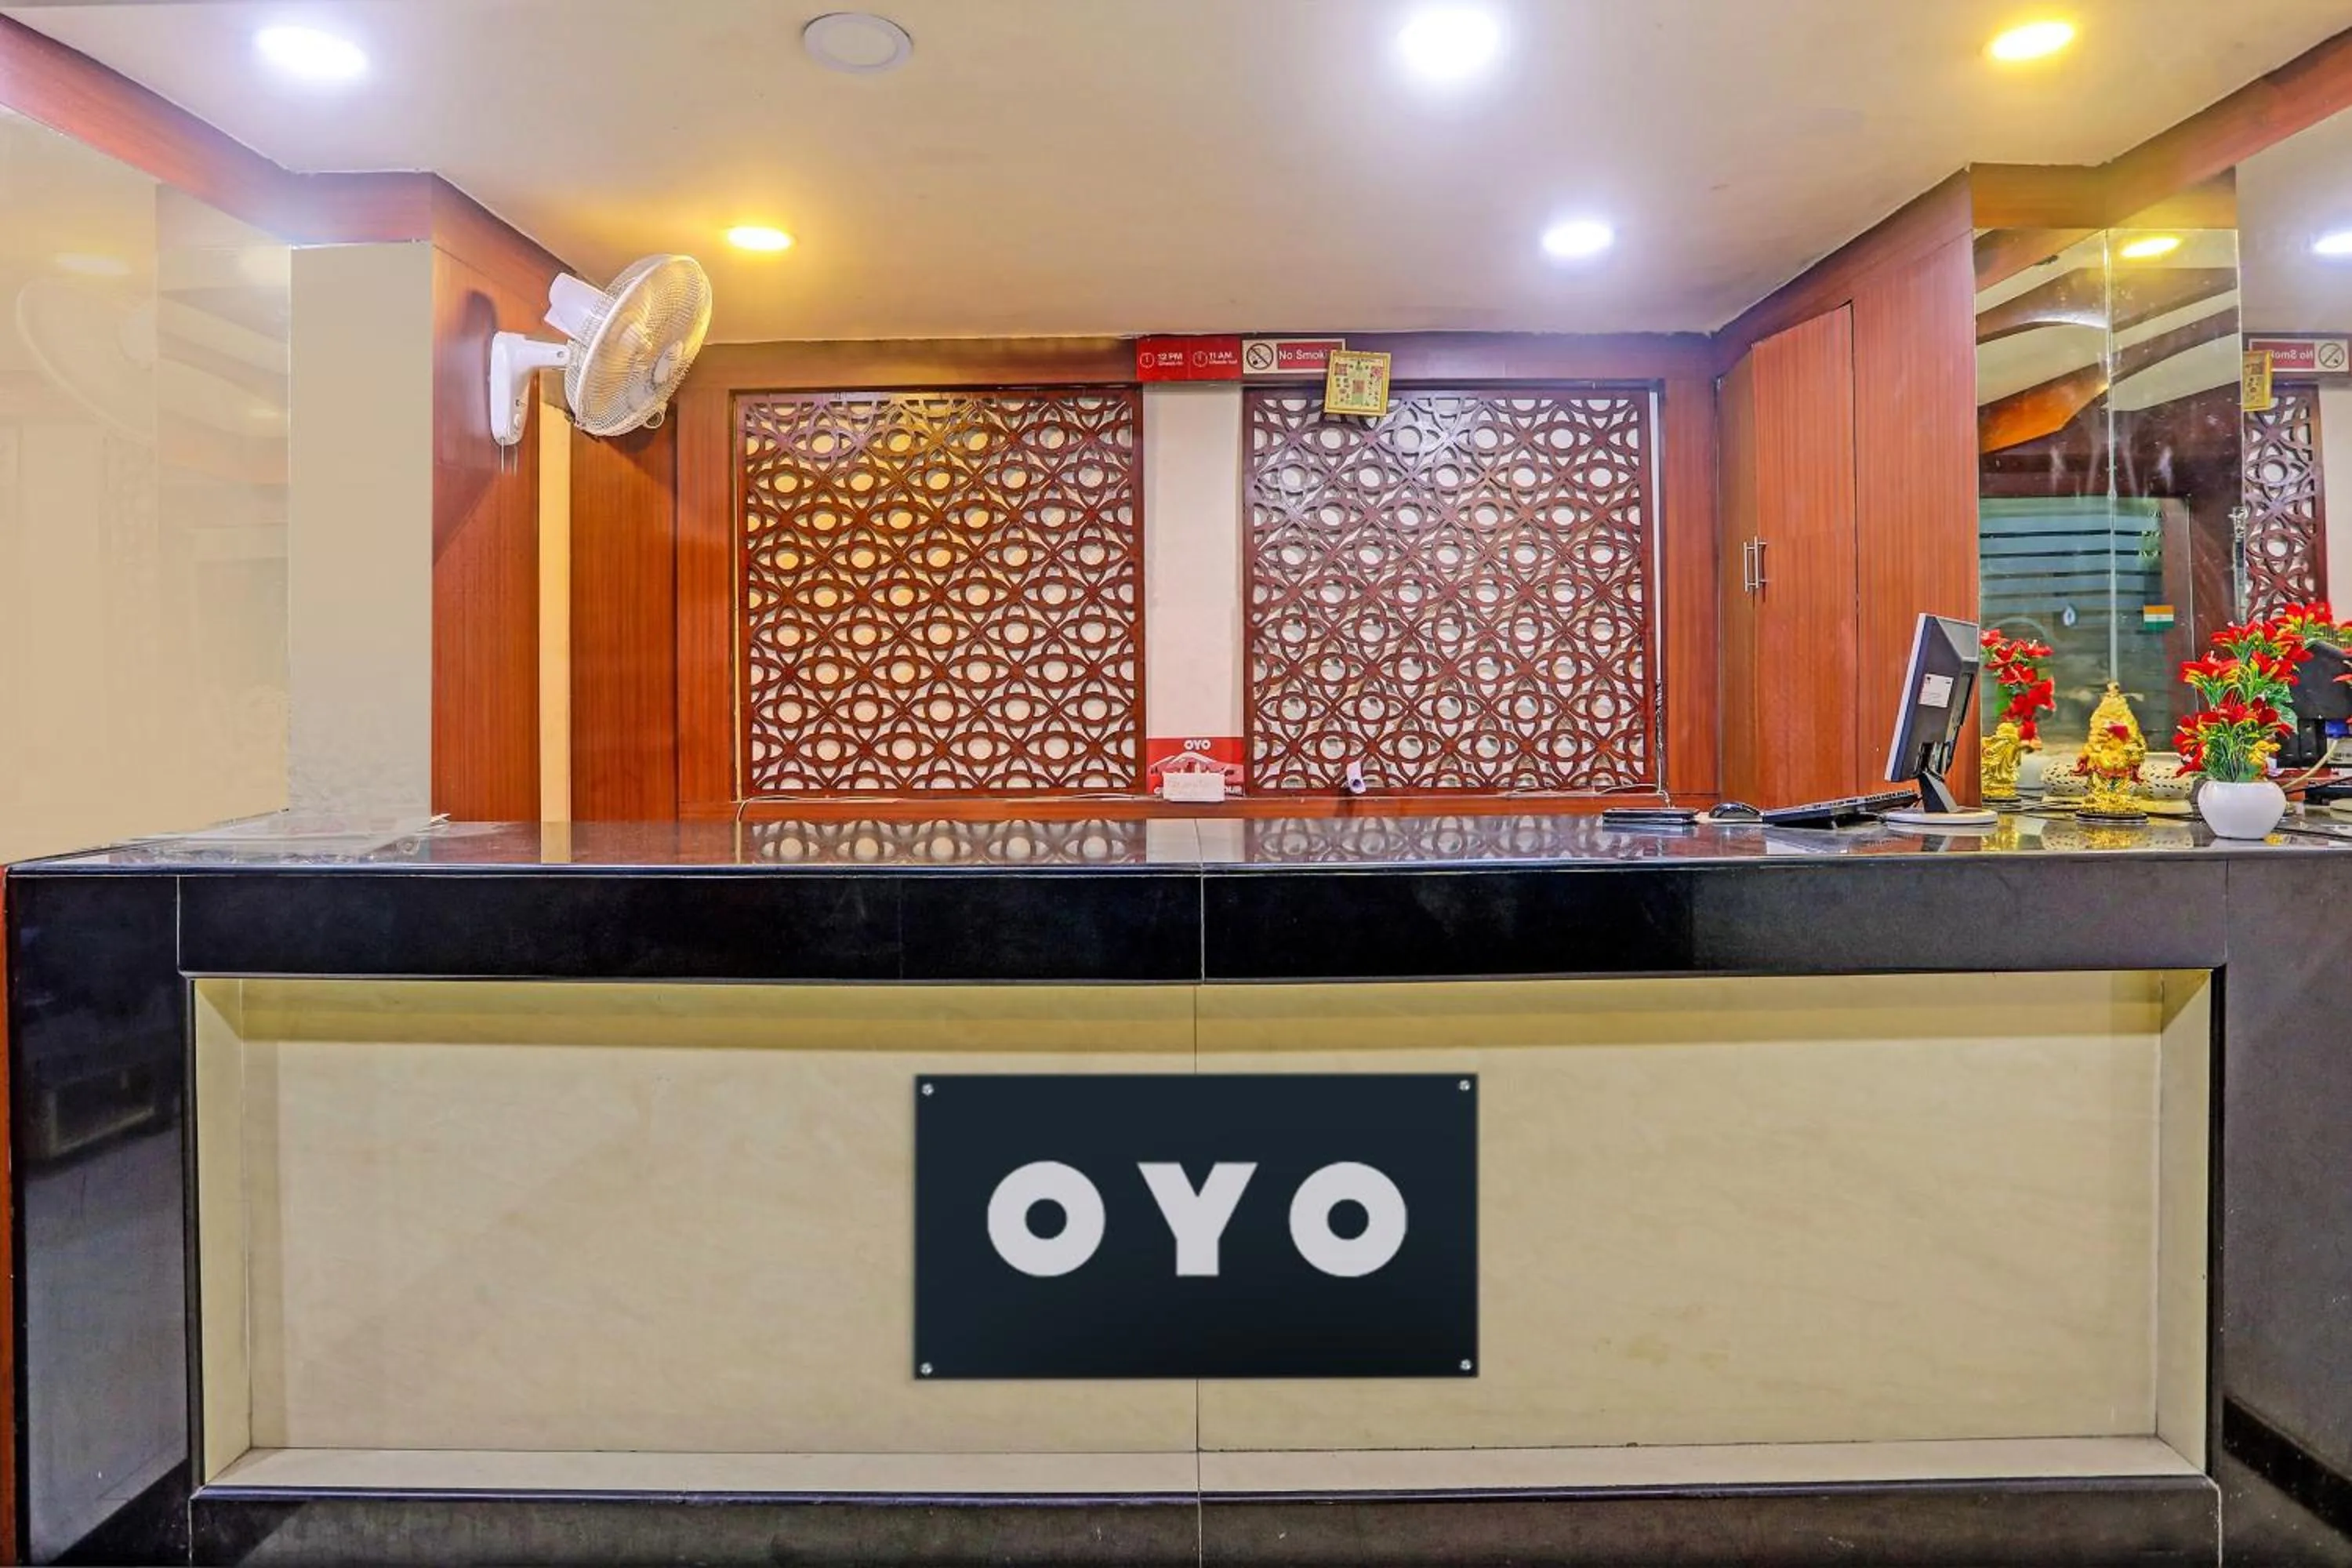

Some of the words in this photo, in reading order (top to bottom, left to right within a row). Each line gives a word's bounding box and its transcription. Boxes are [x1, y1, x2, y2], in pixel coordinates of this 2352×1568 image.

[1279, 350, 1293, 360] No
[1184, 739, 1211, 750] OYO
[987, 1160, 1407, 1276] OYO
